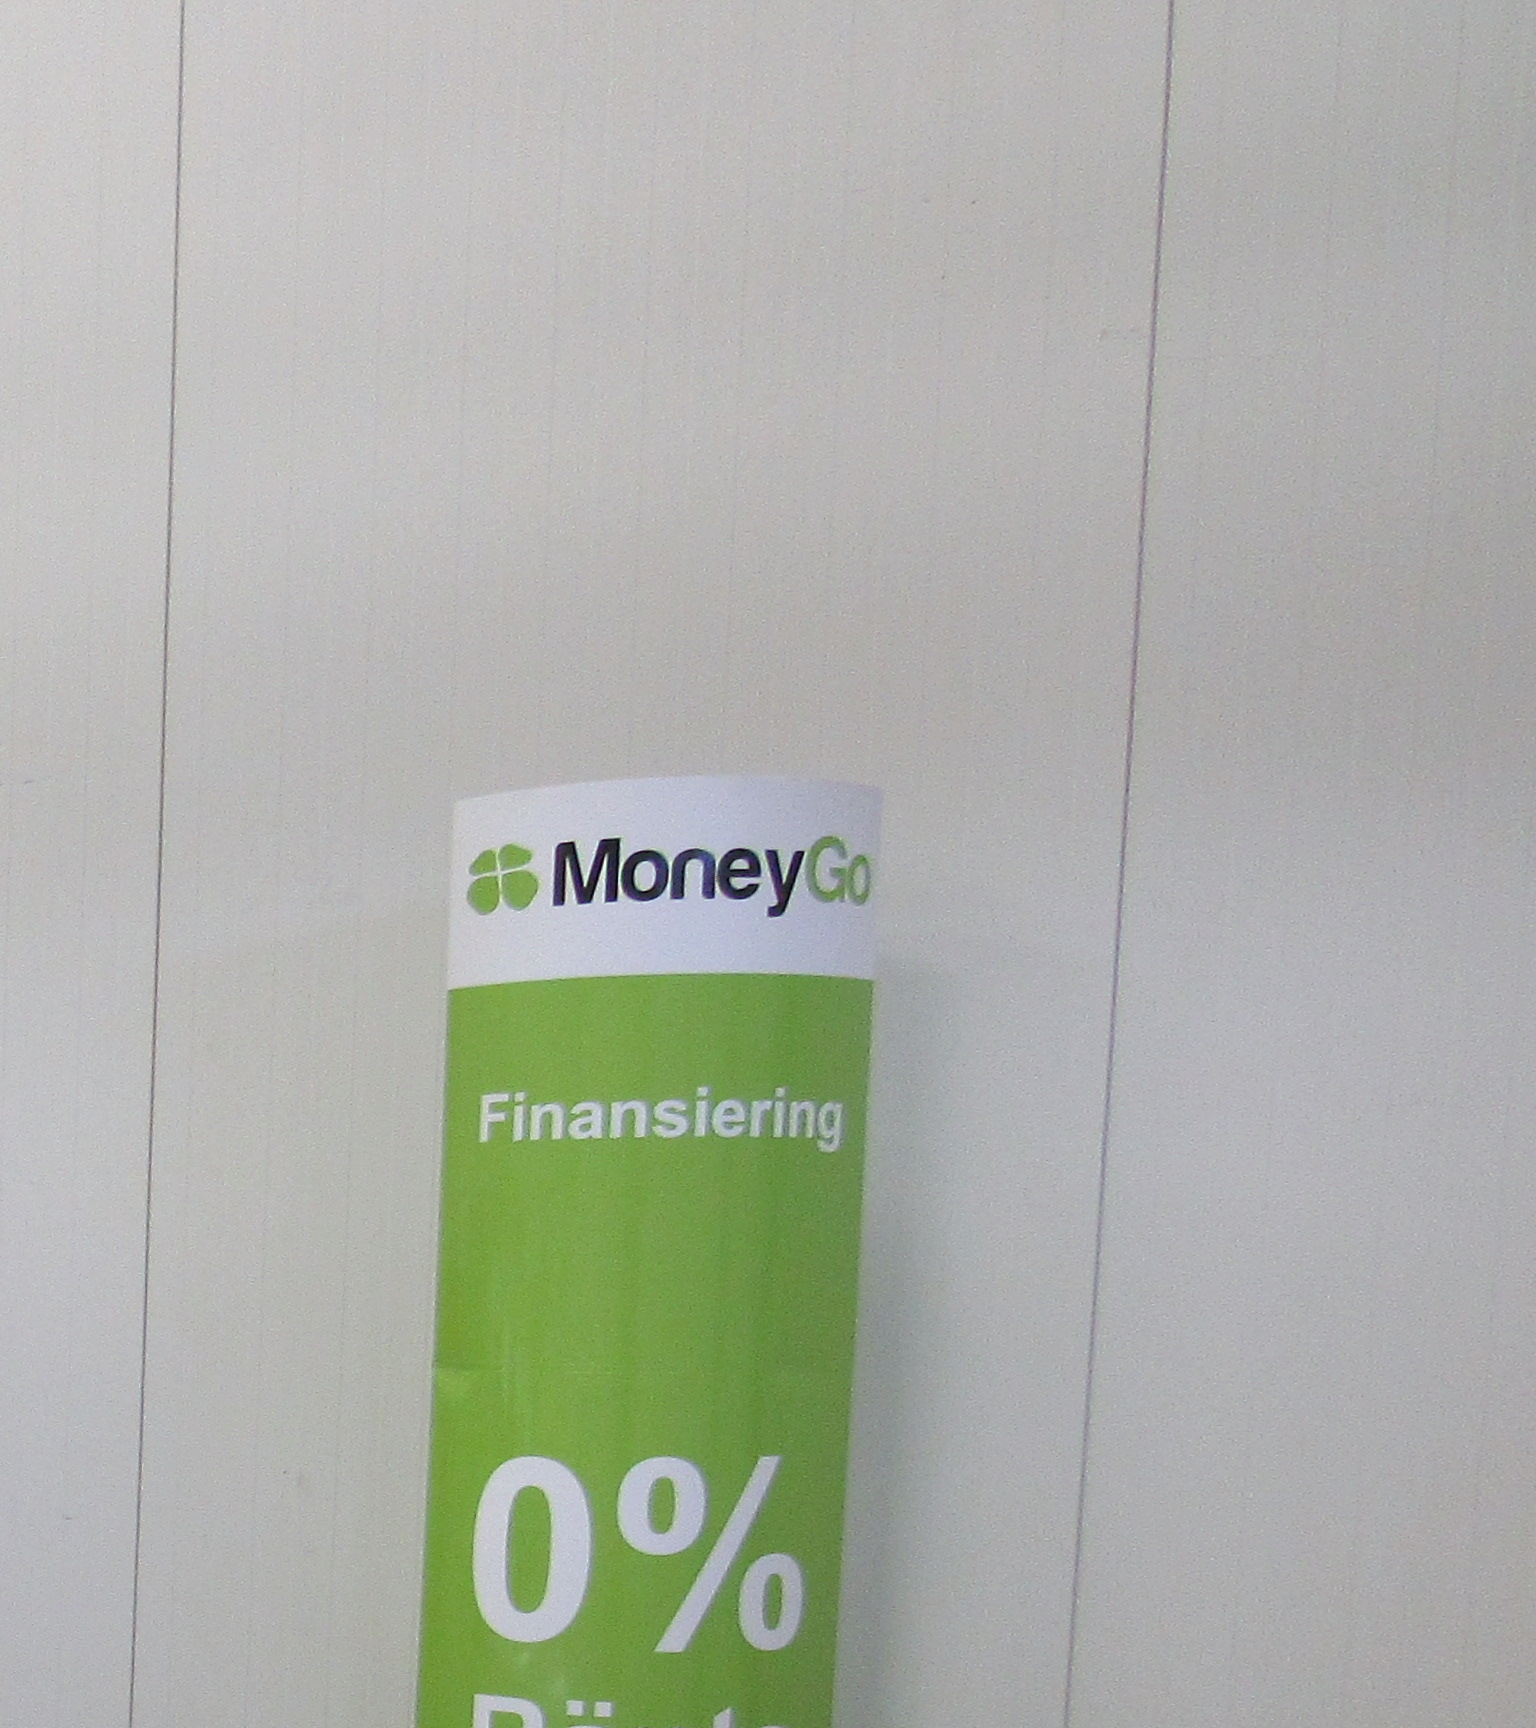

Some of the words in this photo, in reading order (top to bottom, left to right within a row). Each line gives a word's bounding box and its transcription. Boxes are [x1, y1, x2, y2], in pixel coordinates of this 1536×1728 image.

[552, 836, 872, 917] MoneyGo
[478, 1086, 844, 1152] Finansiering
[472, 1455, 805, 1653] 0%
